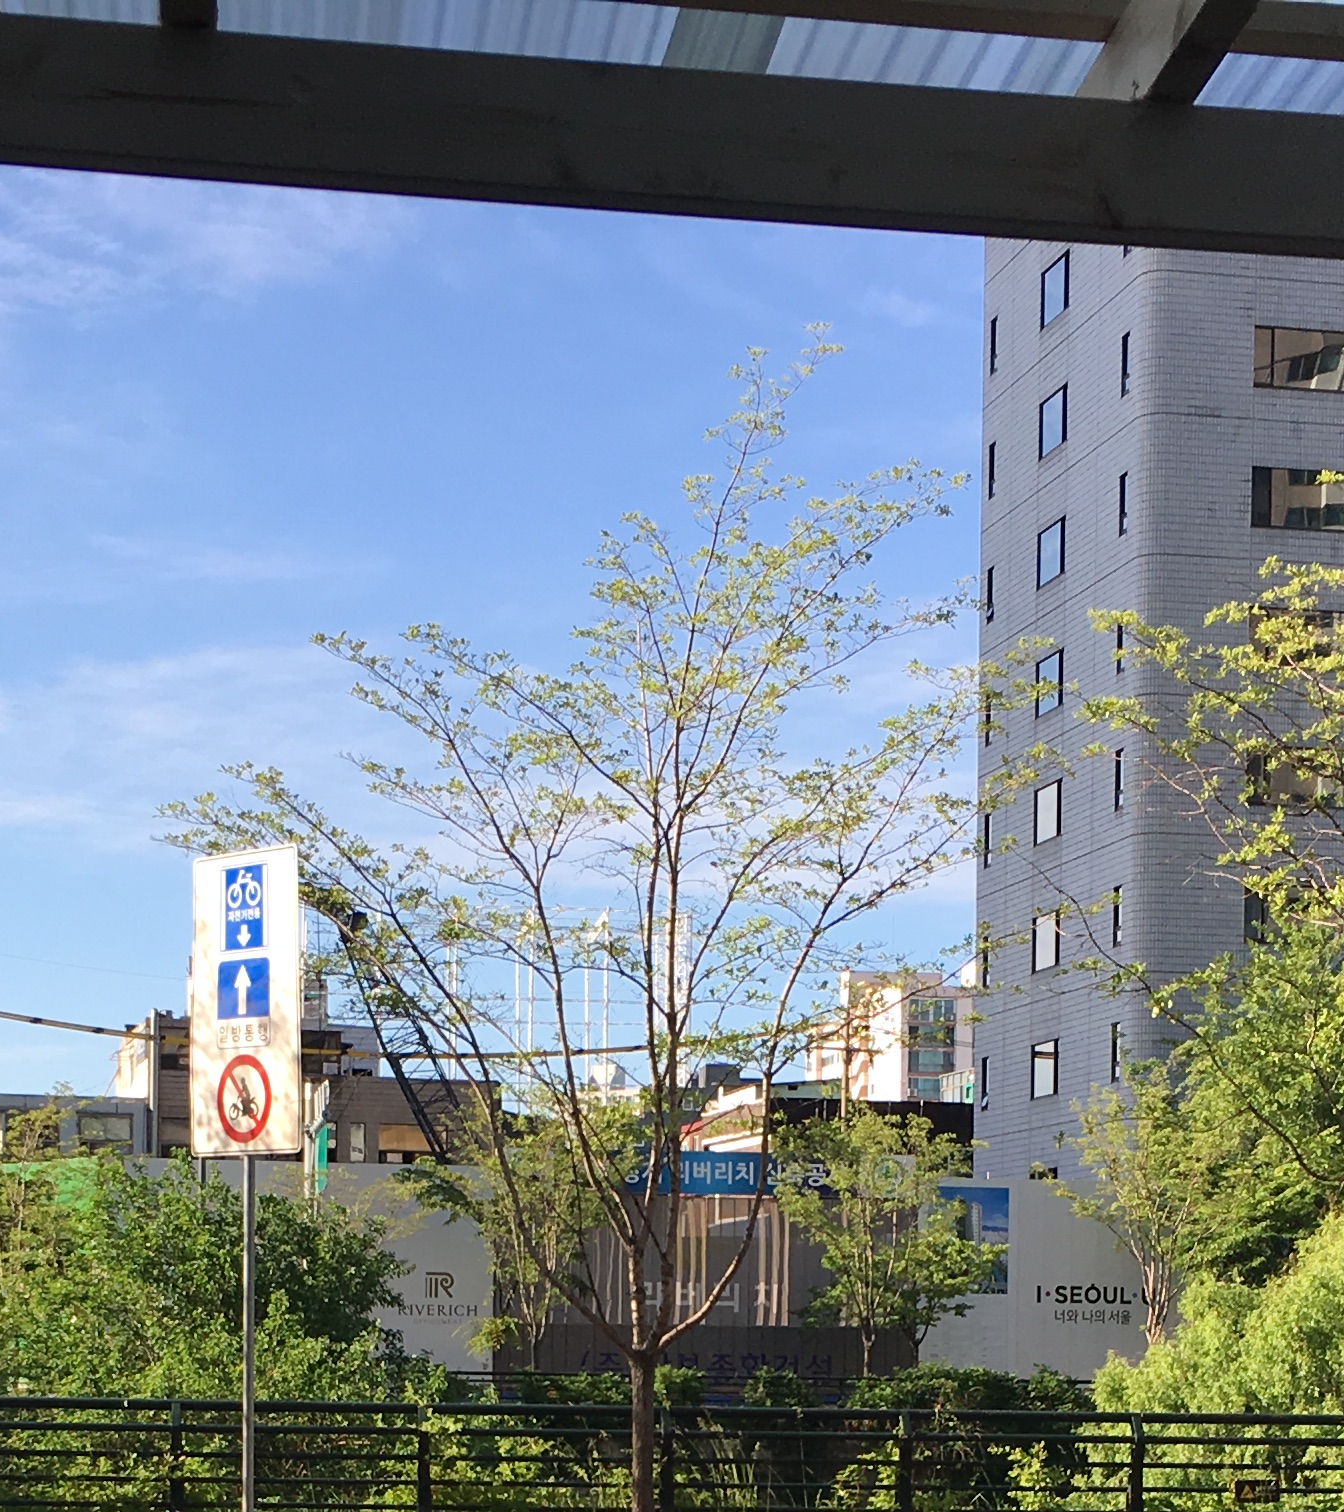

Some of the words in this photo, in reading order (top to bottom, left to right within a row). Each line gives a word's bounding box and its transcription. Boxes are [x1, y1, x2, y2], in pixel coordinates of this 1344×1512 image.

[219, 1022, 269, 1043] 일방통행
[398, 1304, 478, 1317] RIVERICH
[1054, 1309, 1078, 1324] 너와
[1082, 1309, 1106, 1324] 나의
[1108, 1309, 1132, 1325] 서울
